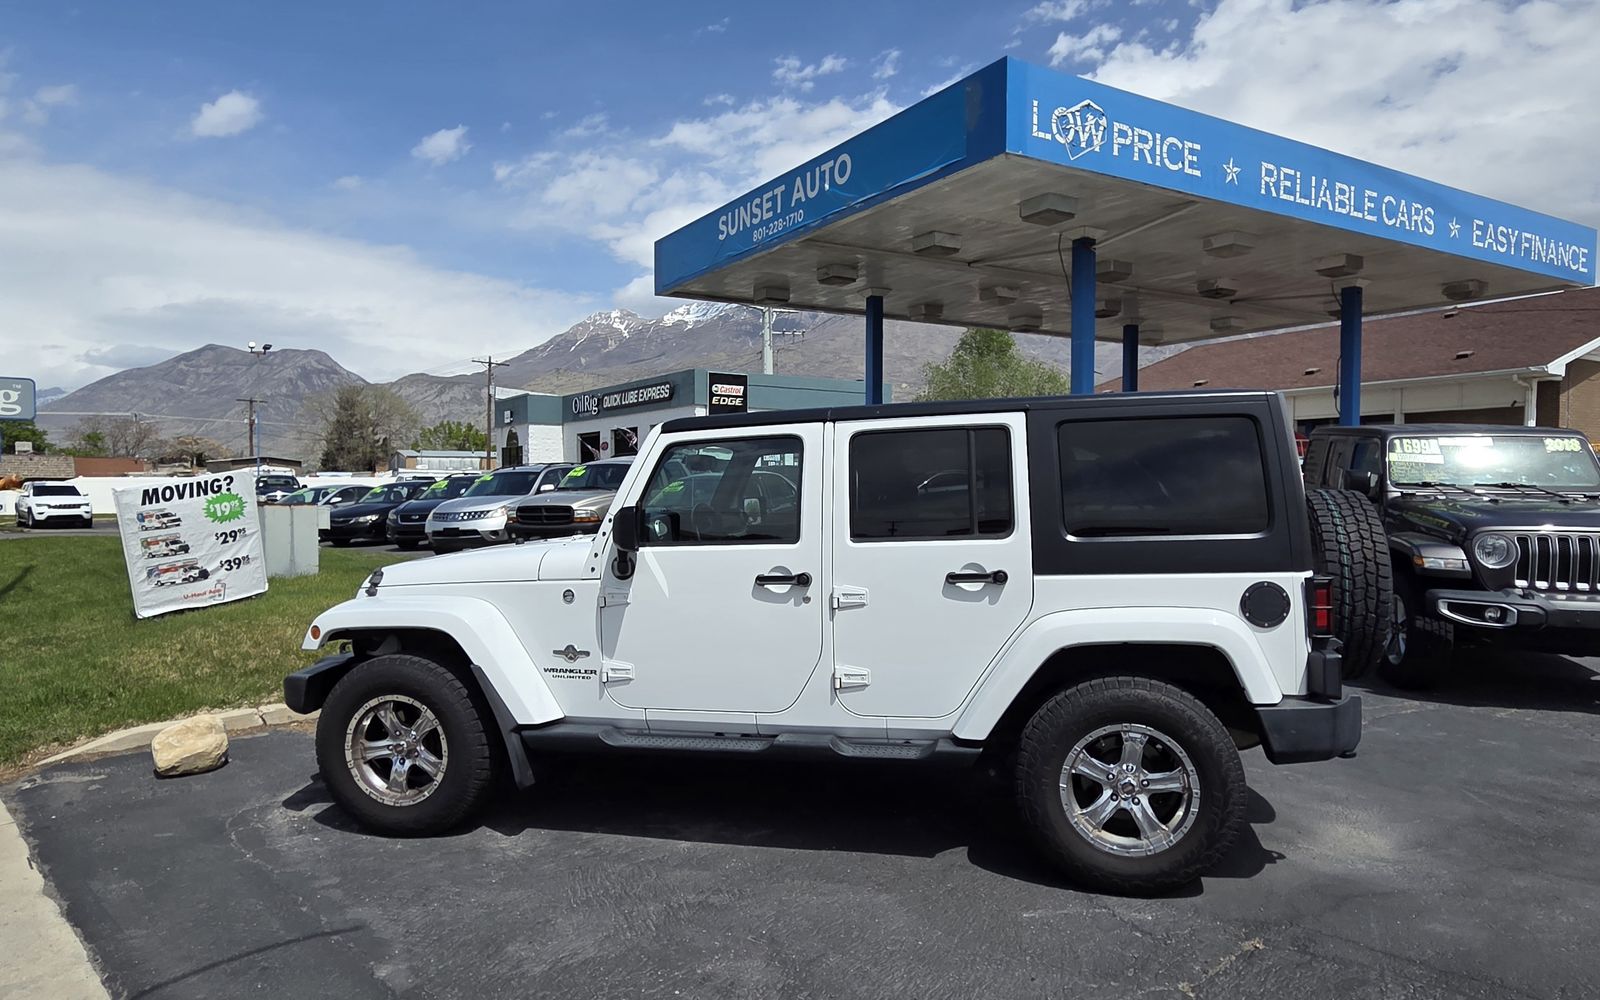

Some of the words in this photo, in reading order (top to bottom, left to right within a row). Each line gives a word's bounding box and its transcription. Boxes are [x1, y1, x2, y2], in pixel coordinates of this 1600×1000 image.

[718, 185, 785, 241] SUNSET
[790, 153, 852, 208] AUTO
[1032, 99, 1107, 153] LOW
[1113, 121, 1201, 177] PRICE
[1260, 161, 1379, 223] RELIABLE
[1381, 195, 1436, 236] CARS
[1472, 219, 1519, 256] EASY
[1520, 232, 1589, 273] FINANCE
[752, 209, 805, 242] 801-228-1710
[602, 394, 621, 409] QUICK
[621, 389, 639, 405] LUBE
[638, 383, 670, 402] EXPRESS
[711, 396, 744, 406] EDGE
[719, 385, 743, 395] Castrol
[140, 475, 235, 507] MOVING?
[543, 667, 598, 676] WRANGLER
